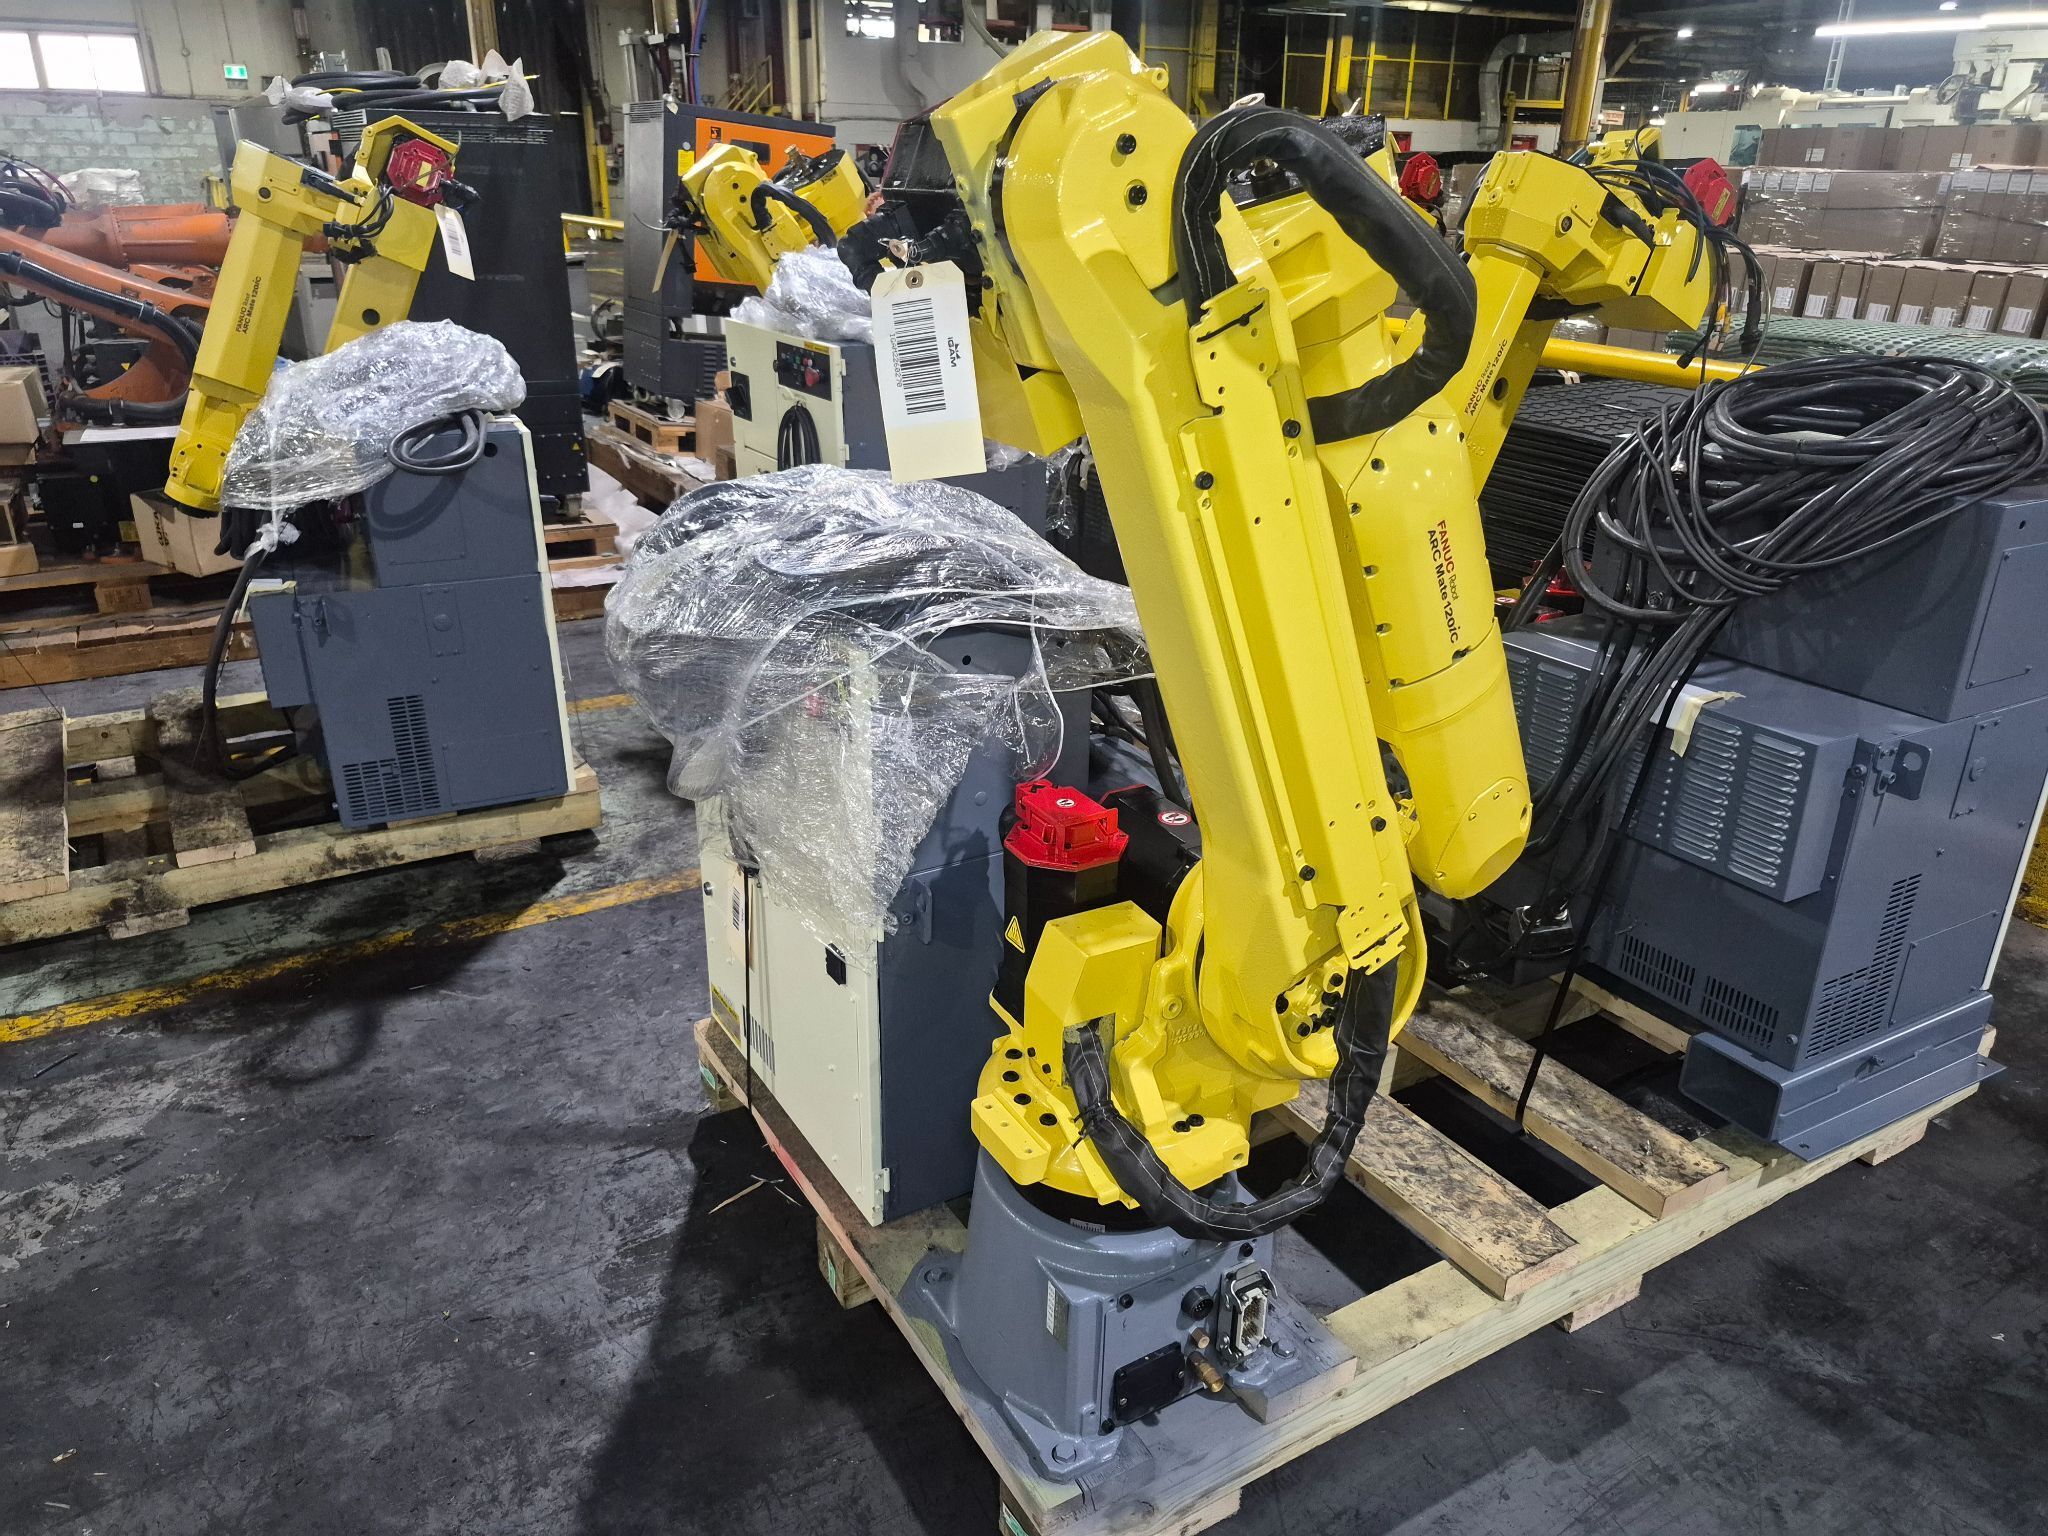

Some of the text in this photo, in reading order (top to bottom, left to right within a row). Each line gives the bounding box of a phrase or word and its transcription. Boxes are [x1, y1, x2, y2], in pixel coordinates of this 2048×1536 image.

[235, 306, 247, 333] FANUC
[241, 317, 251, 335] ARC
[246, 299, 256, 318] Mate
[1464, 379, 1482, 415] FANUC
[1469, 338, 1508, 417] ARC Mate 120iC
[1427, 529, 1461, 644] ARC Mate 120iC
[1437, 519, 1459, 601] FANUC Robot
